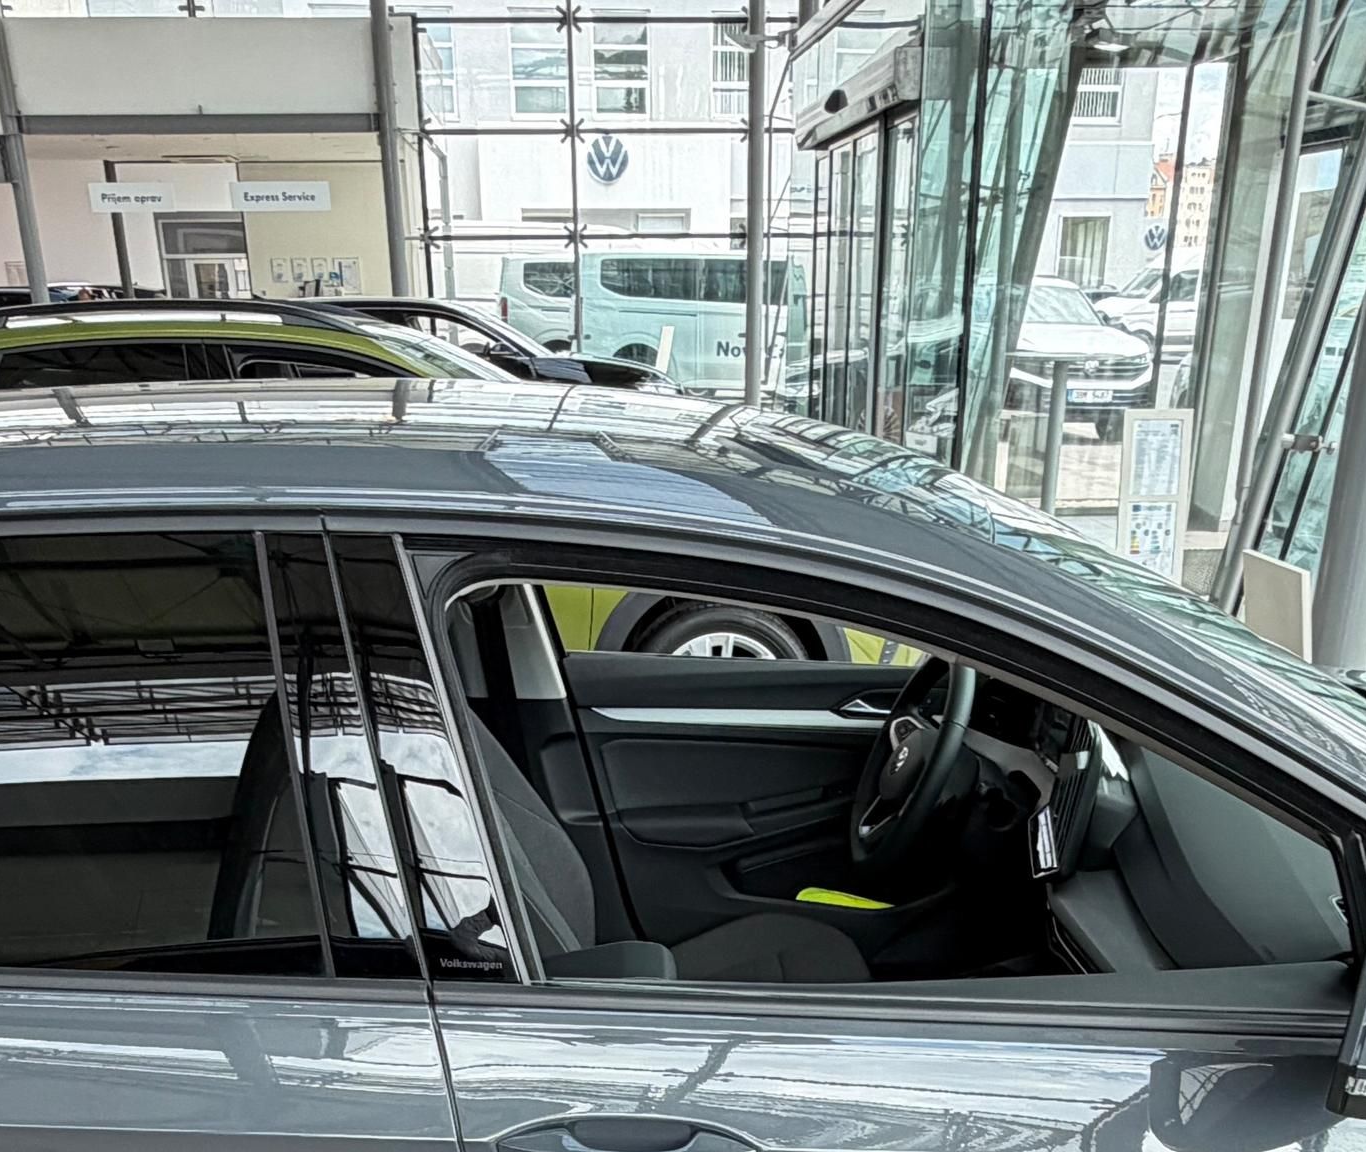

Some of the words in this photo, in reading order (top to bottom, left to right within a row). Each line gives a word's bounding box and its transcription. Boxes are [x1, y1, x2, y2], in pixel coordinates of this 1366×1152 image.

[244, 191, 280, 203] Express
[282, 191, 316, 202] Service
[439, 957, 503, 972] Volkswagen
